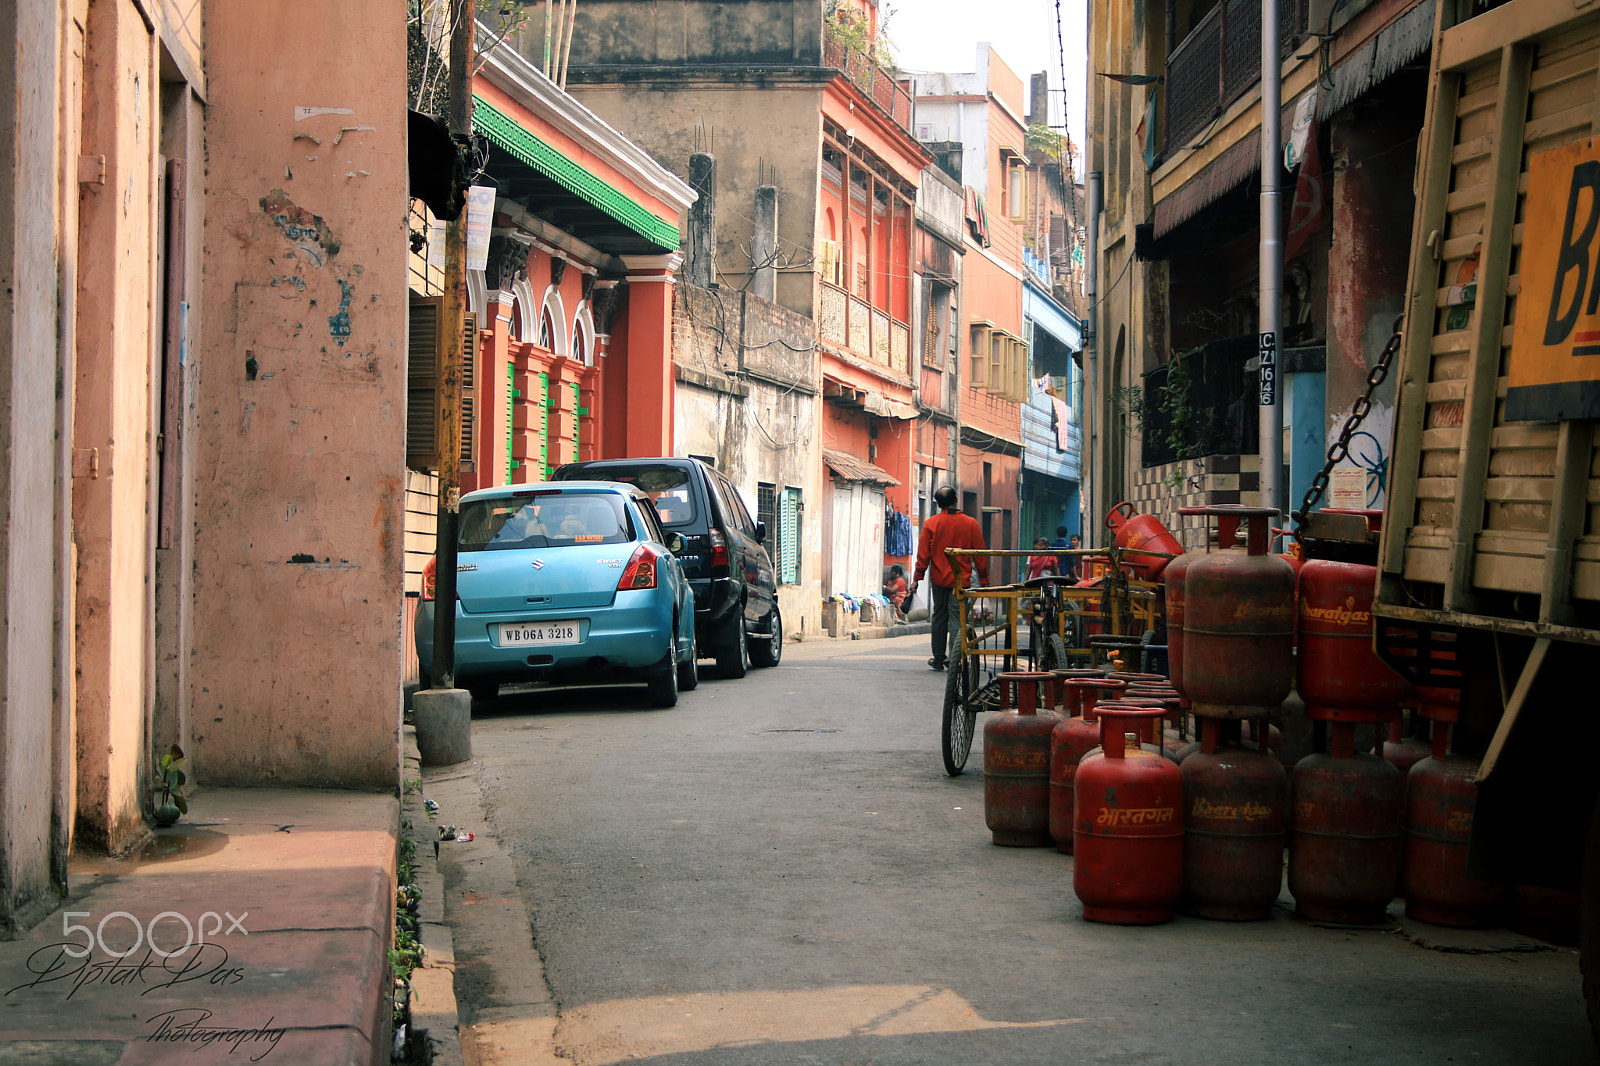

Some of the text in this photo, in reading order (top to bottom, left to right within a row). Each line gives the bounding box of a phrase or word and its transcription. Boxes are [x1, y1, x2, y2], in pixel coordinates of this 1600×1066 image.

[505, 627, 573, 641] WB 06A 3218
